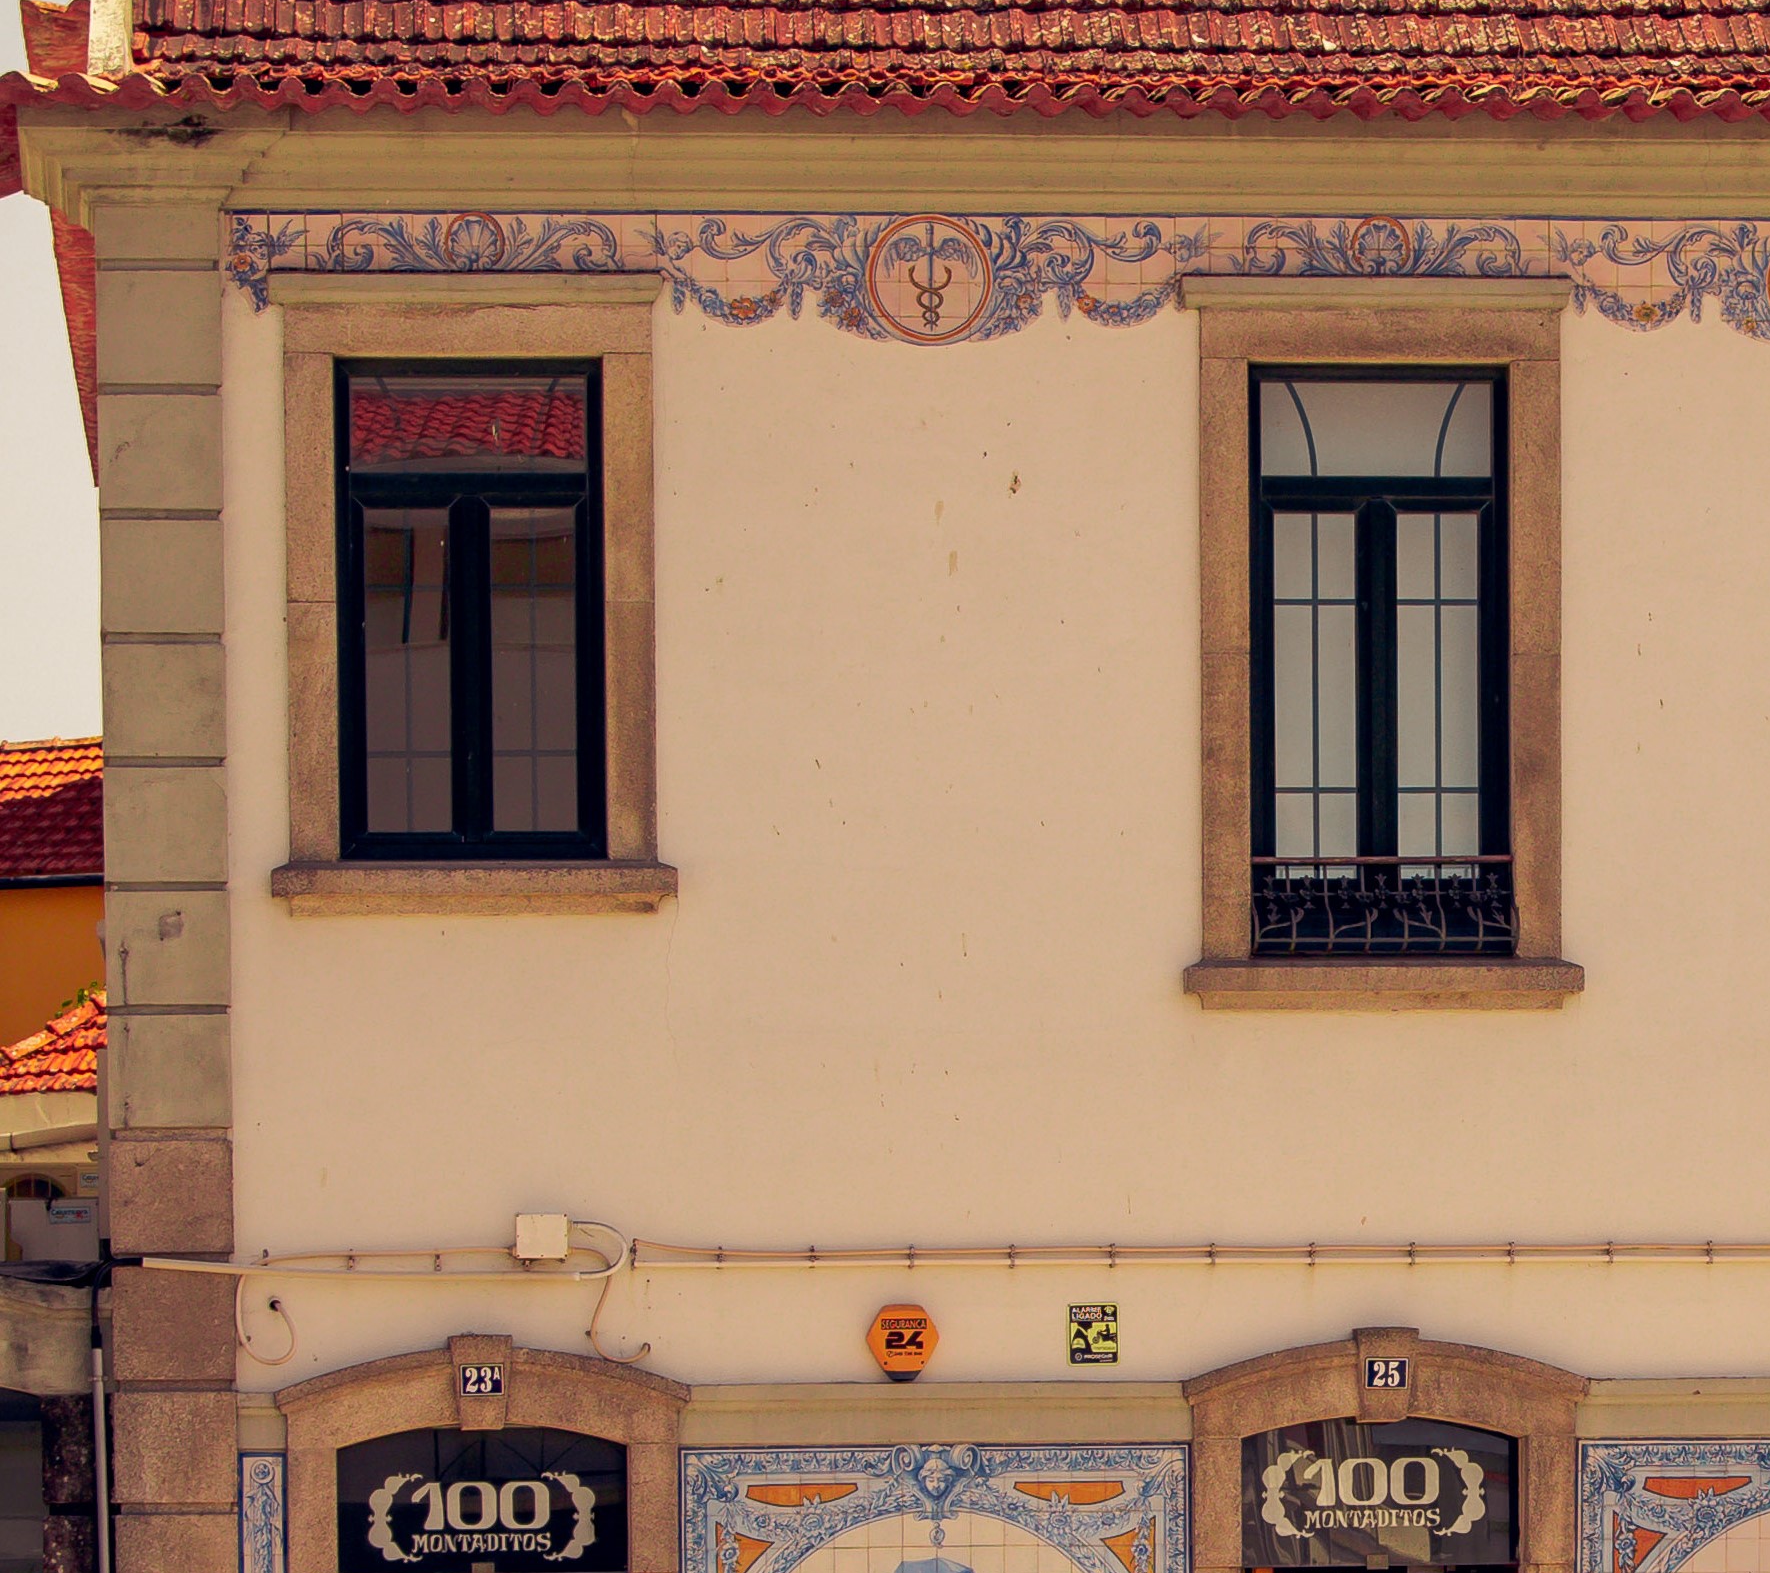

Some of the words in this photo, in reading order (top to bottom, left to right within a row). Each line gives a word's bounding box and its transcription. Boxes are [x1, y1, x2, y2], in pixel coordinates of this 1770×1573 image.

[885, 1331, 924, 1349] 24
[465, 1367, 501, 1393] 23A
[1373, 1361, 1400, 1387] 25
[1303, 1458, 1440, 1507] 100
[411, 1481, 550, 1530] 100
[1304, 1508, 1441, 1529] MONTADITOS
[412, 1532, 552, 1554] MONTADITOS
